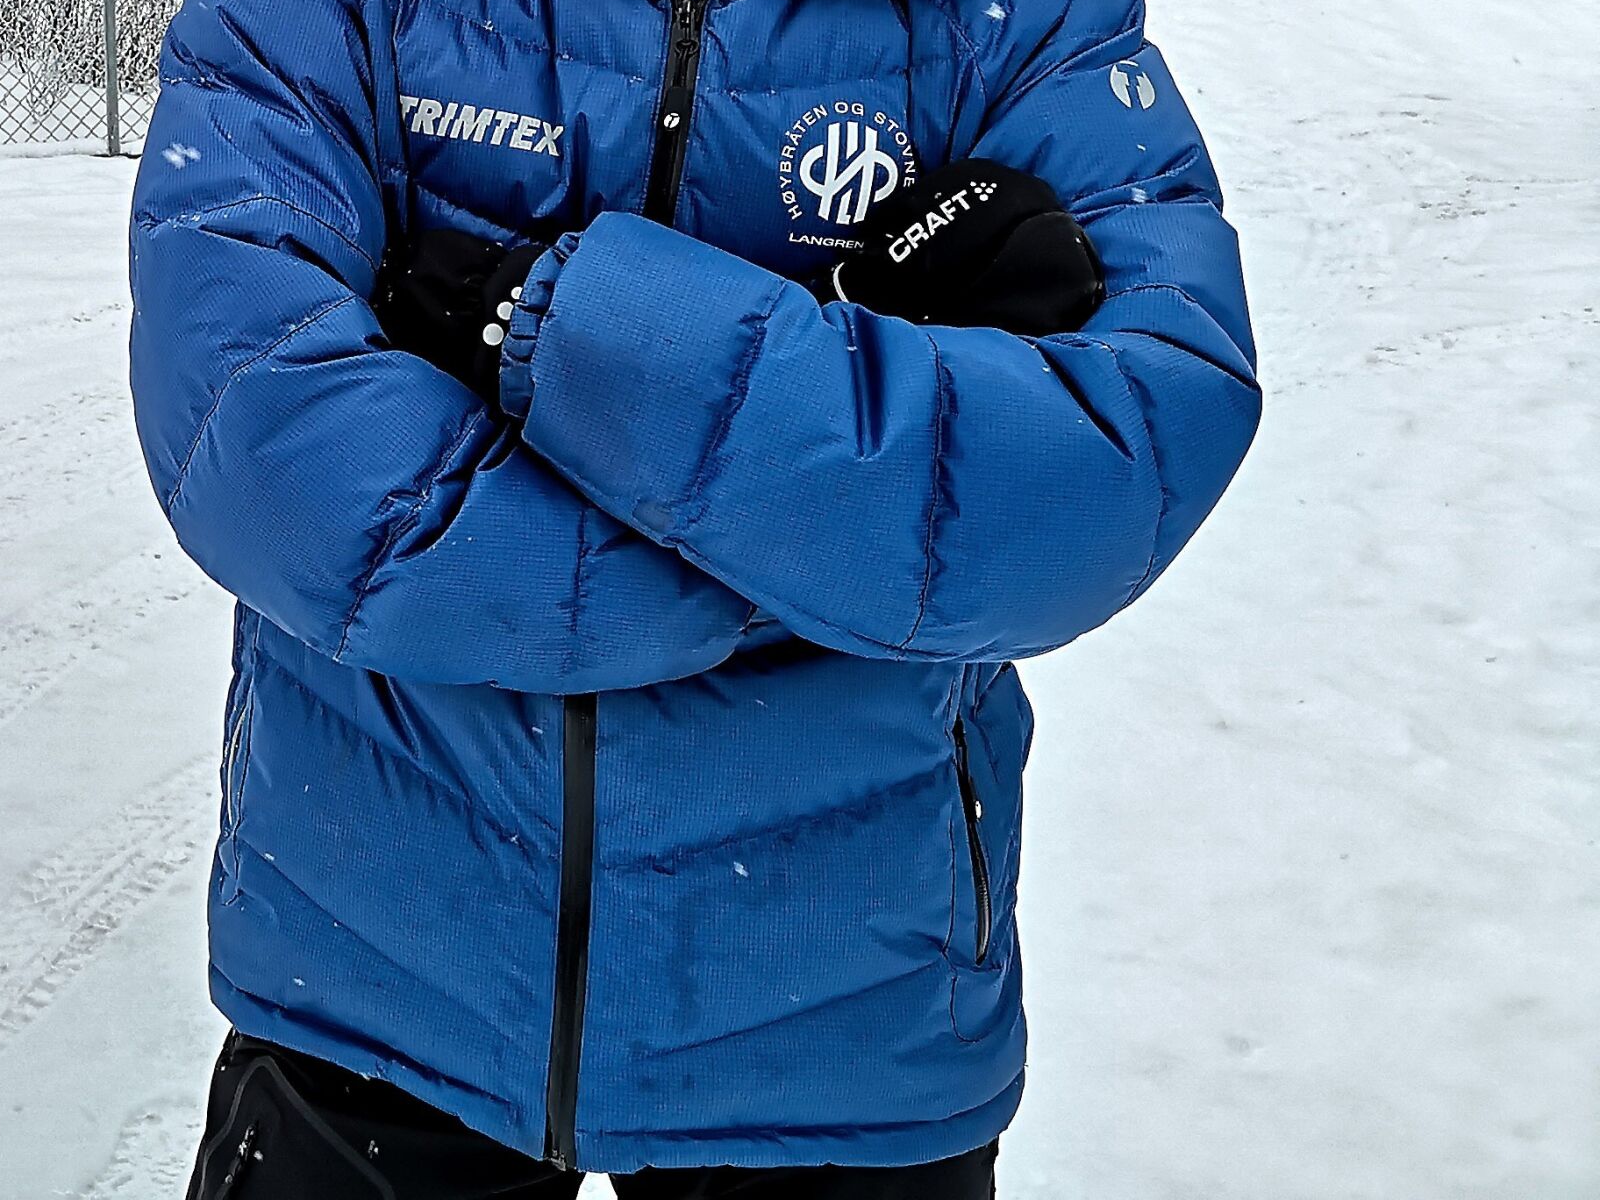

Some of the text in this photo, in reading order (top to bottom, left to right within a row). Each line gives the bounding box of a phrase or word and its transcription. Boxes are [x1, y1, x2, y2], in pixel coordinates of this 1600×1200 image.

[399, 94, 564, 157] TRIMTEX
[779, 104, 828, 220] HØYBRÅTEN
[834, 101, 864, 116] OG
[888, 189, 971, 264] CRAFT
